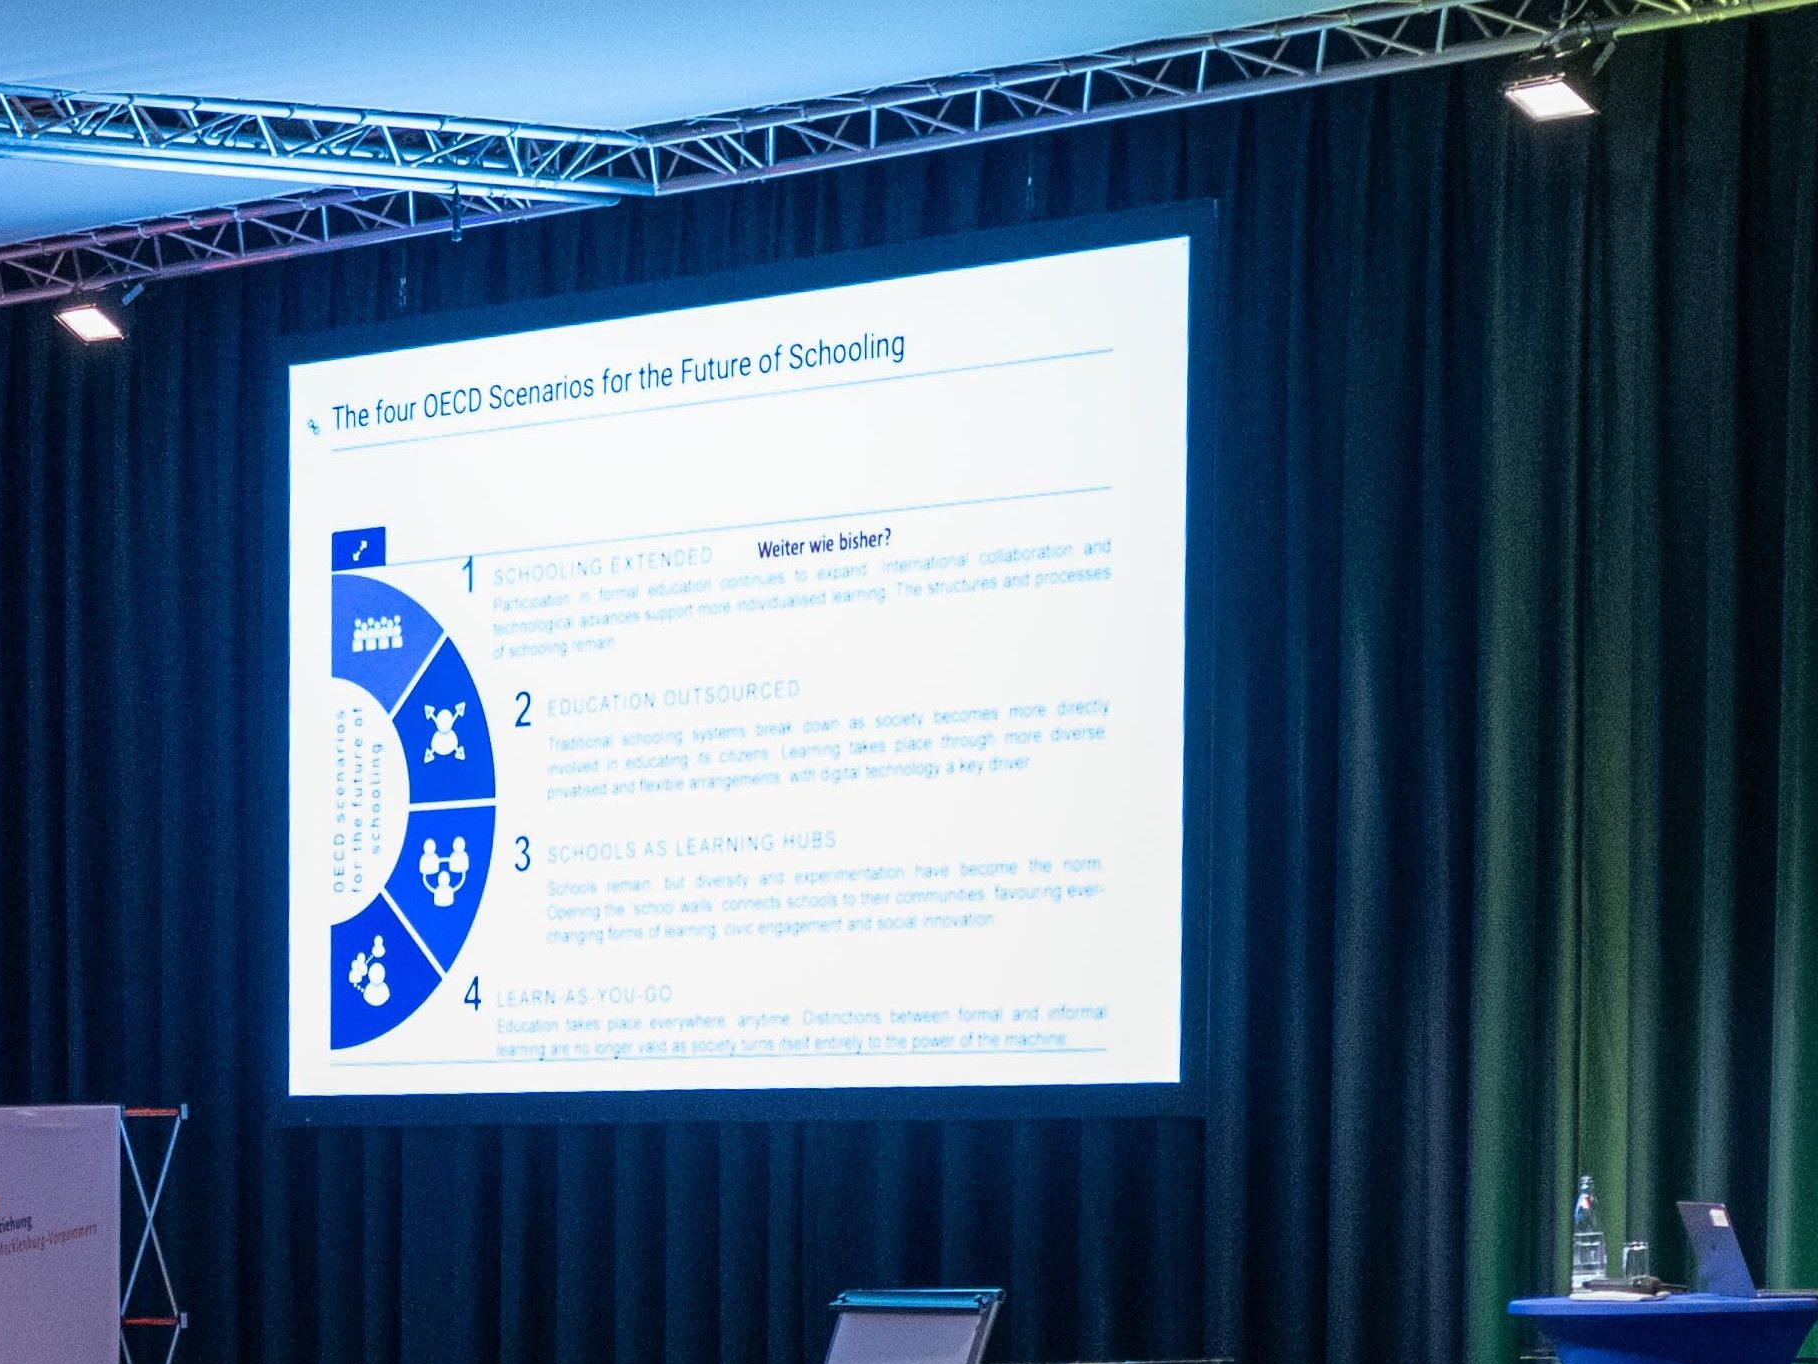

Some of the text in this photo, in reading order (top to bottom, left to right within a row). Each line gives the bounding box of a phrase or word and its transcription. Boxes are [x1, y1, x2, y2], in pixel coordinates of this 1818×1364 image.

[331, 327, 904, 431] The four OECD Scenarios for the Future of Schooling
[757, 527, 891, 559] Weiter wie bisher?
[462, 555, 474, 593] 1
[493, 545, 713, 587] SCHOOLING EXTENDED
[514, 690, 532, 727] 2
[546, 677, 802, 718] EDUCATION OUTSOURCED
[514, 835, 531, 872] 3
[545, 829, 836, 866] SCHOOLS AS LEARNING HUBS
[463, 975, 481, 1011] 4
